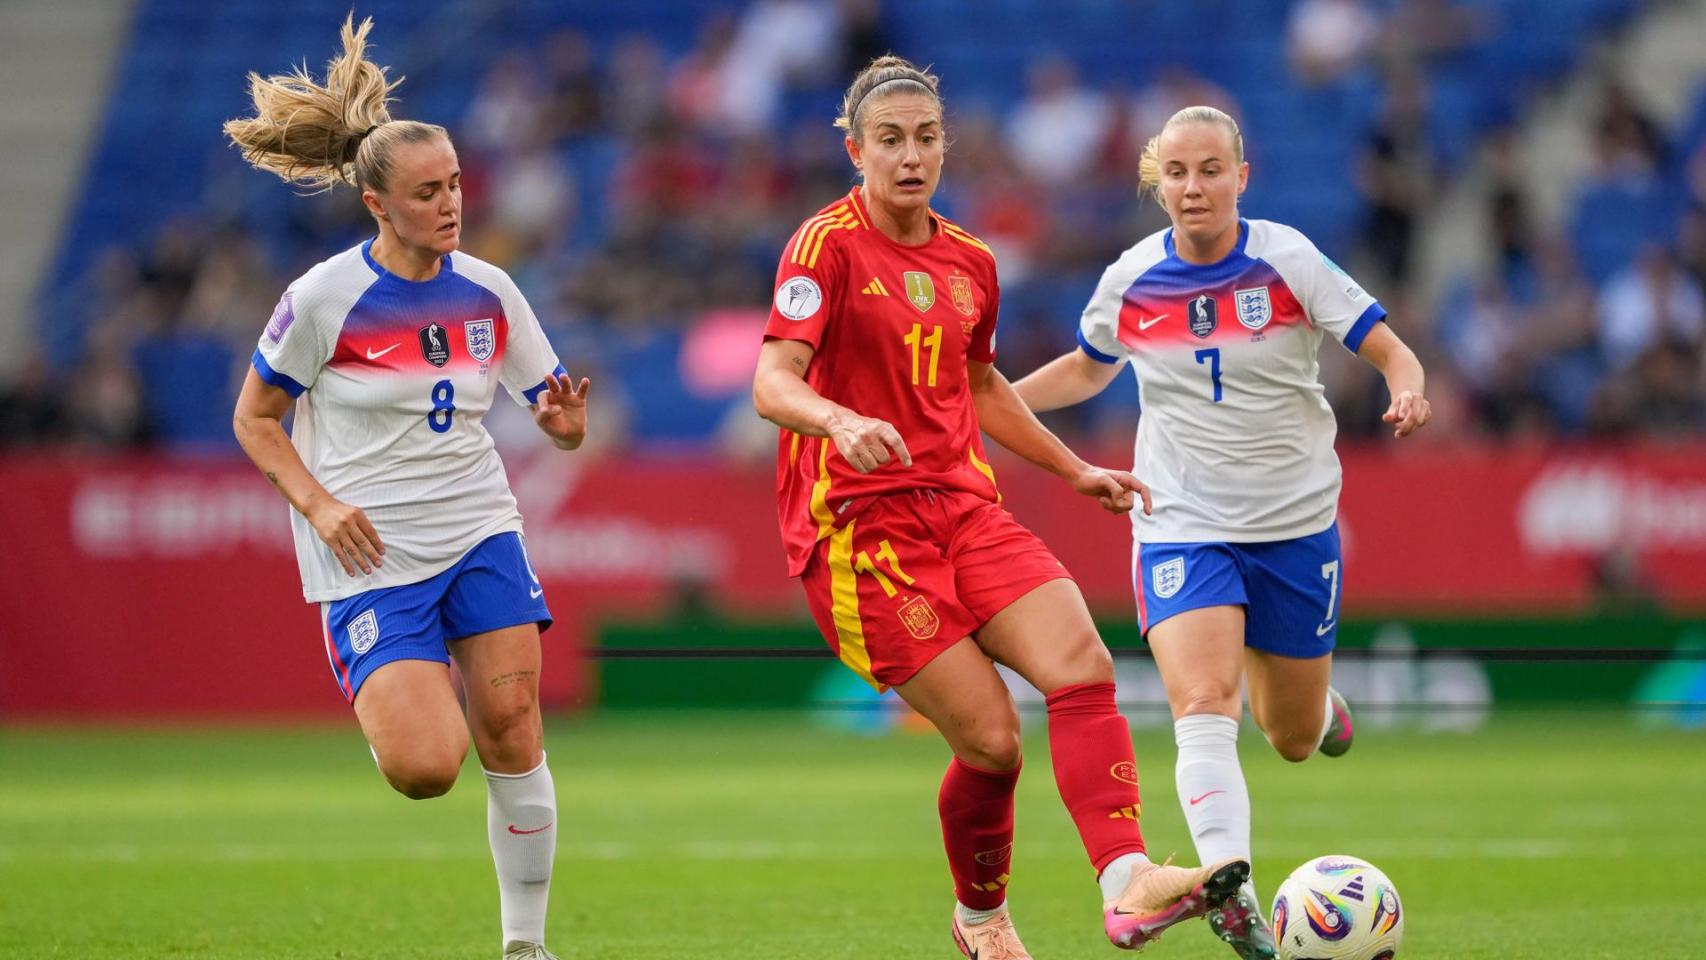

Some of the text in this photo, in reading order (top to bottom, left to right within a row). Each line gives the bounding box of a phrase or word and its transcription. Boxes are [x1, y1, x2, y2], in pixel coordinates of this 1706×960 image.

[904, 323, 943, 387] 11
[1195, 348, 1222, 402] 7
[427, 379, 456, 434] 8
[854, 539, 917, 598] 11
[1321, 560, 1338, 620] 7
